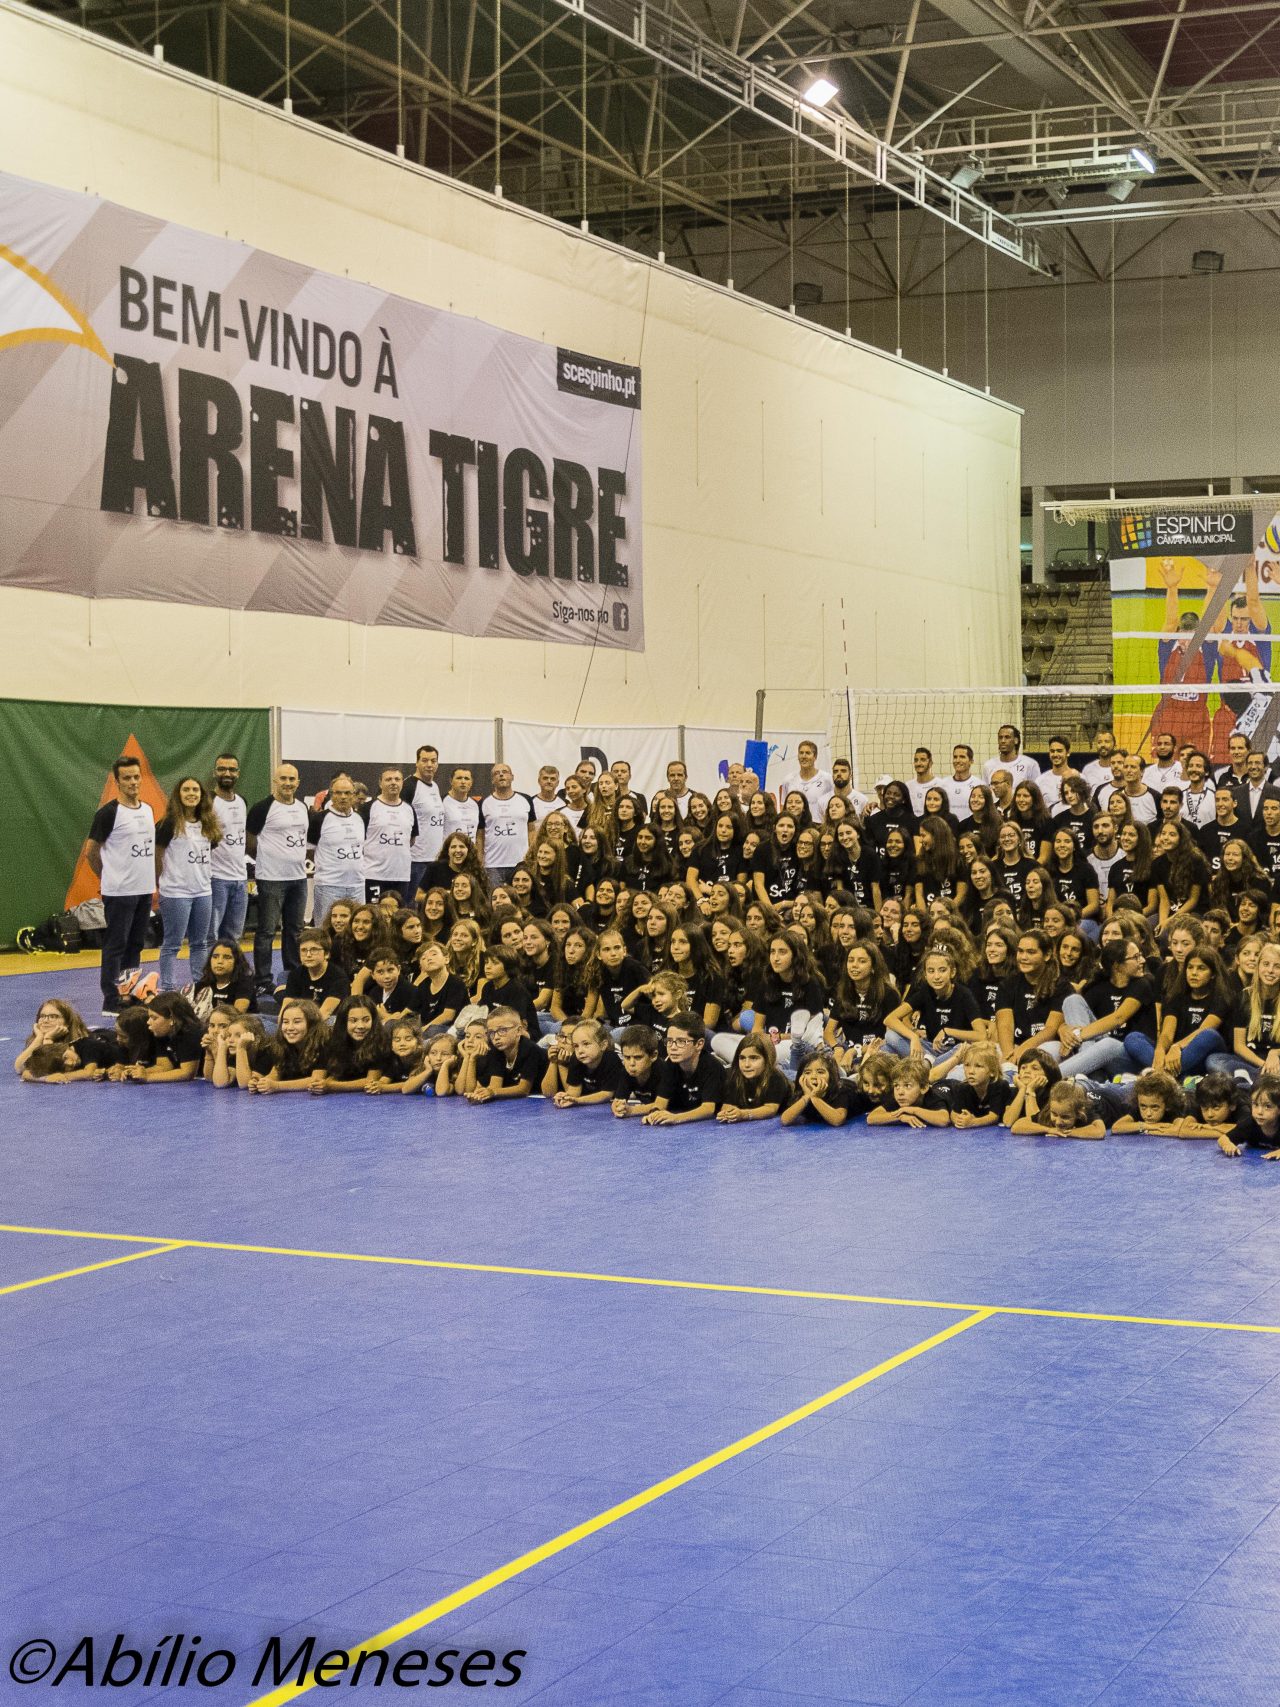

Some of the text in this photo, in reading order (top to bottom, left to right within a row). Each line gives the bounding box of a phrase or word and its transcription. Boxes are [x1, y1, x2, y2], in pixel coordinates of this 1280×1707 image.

[120, 265, 399, 399] BEM-VINDO À
[563, 362, 636, 399] scespinho.pt
[100, 352, 628, 588] ARENA TIGRE
[1156, 513, 1236, 534] ESPINHO
[1192, 533, 1236, 544] MUNICIPAL
[552, 600, 595, 624] Siga-nos
[598, 609, 609, 624] no
[1026, 840, 1036, 850] 18
[785, 868, 796, 878] 19
[1009, 883, 1022, 894] 15
